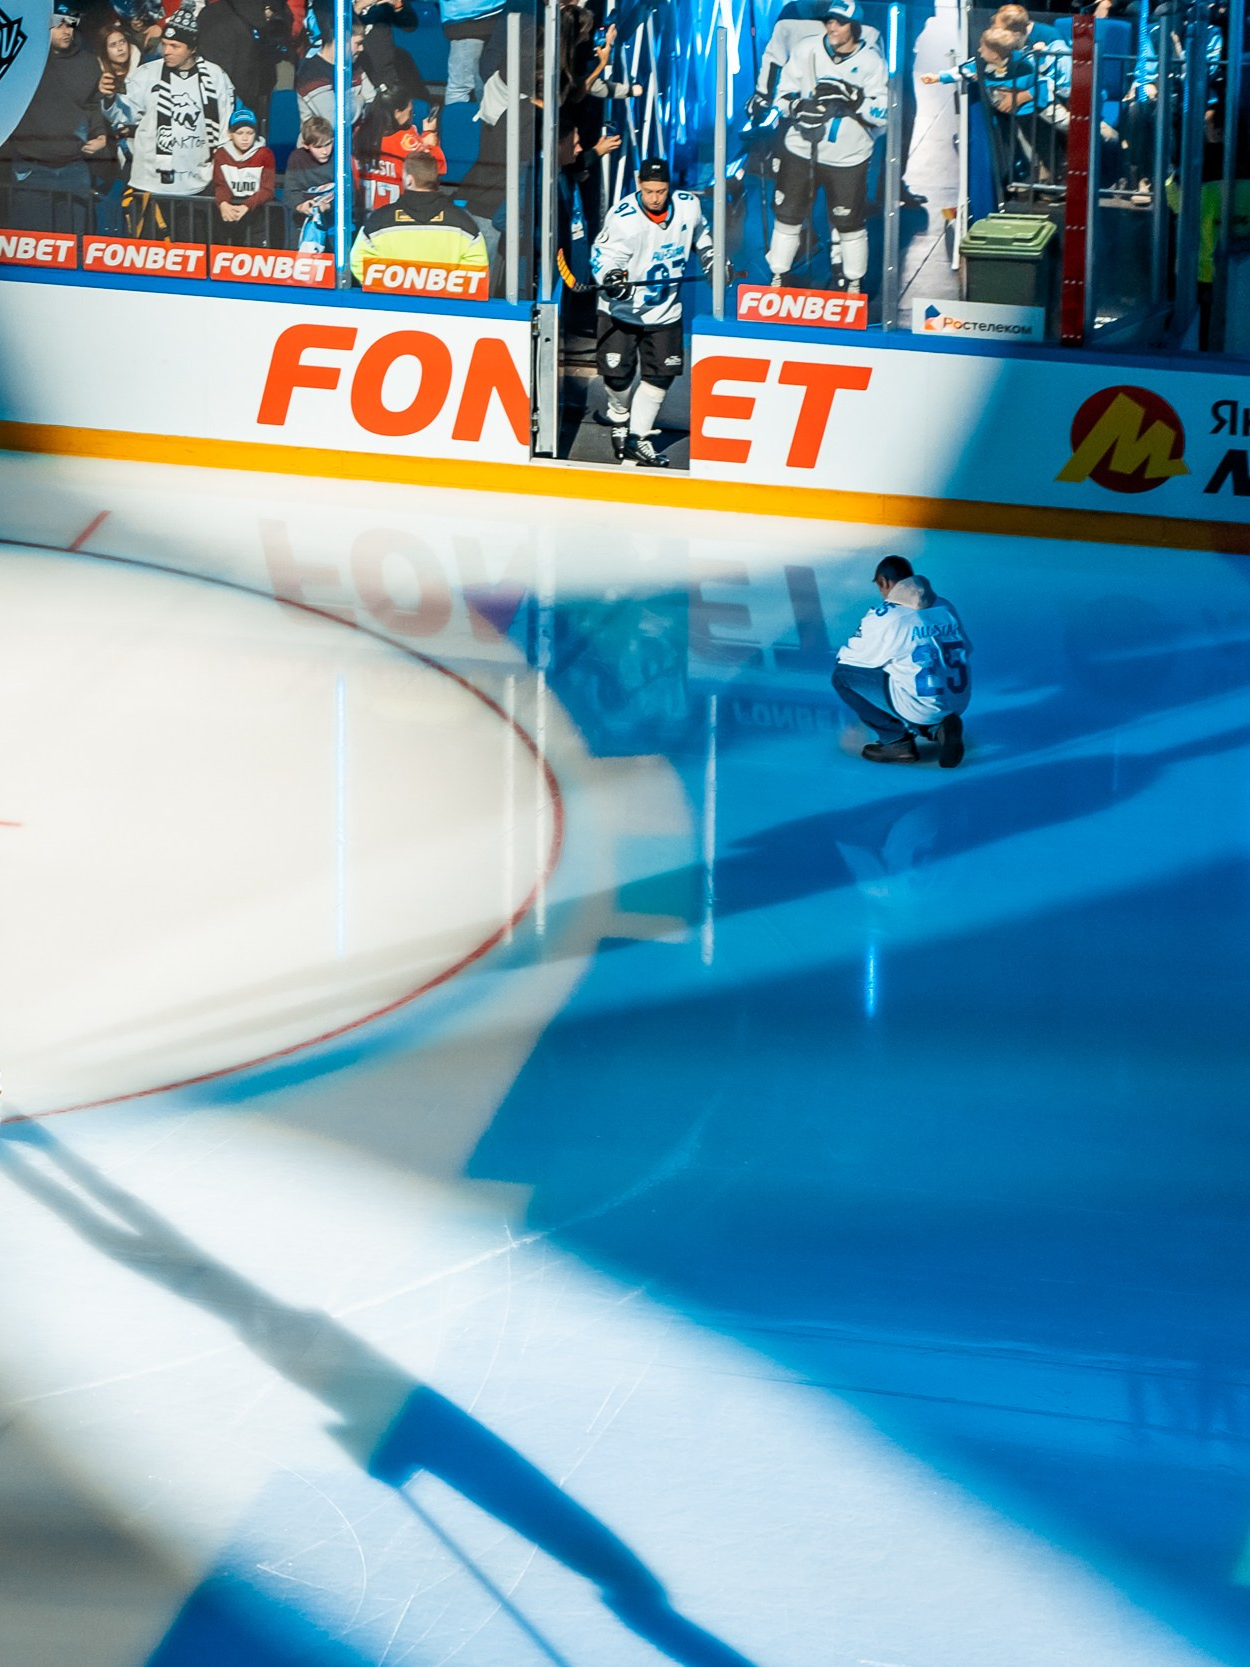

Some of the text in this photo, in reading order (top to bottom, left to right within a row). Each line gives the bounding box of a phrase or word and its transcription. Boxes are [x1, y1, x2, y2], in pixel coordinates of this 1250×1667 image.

[614, 202, 637, 218] 97
[85, 242, 206, 273] FONBET
[211, 251, 333, 283] FONBET
[364, 262, 487, 294] FONBET
[738, 291, 866, 324] FONBET
[943, 316, 1032, 335] Ростелеком
[911, 640, 969, 697] 25
